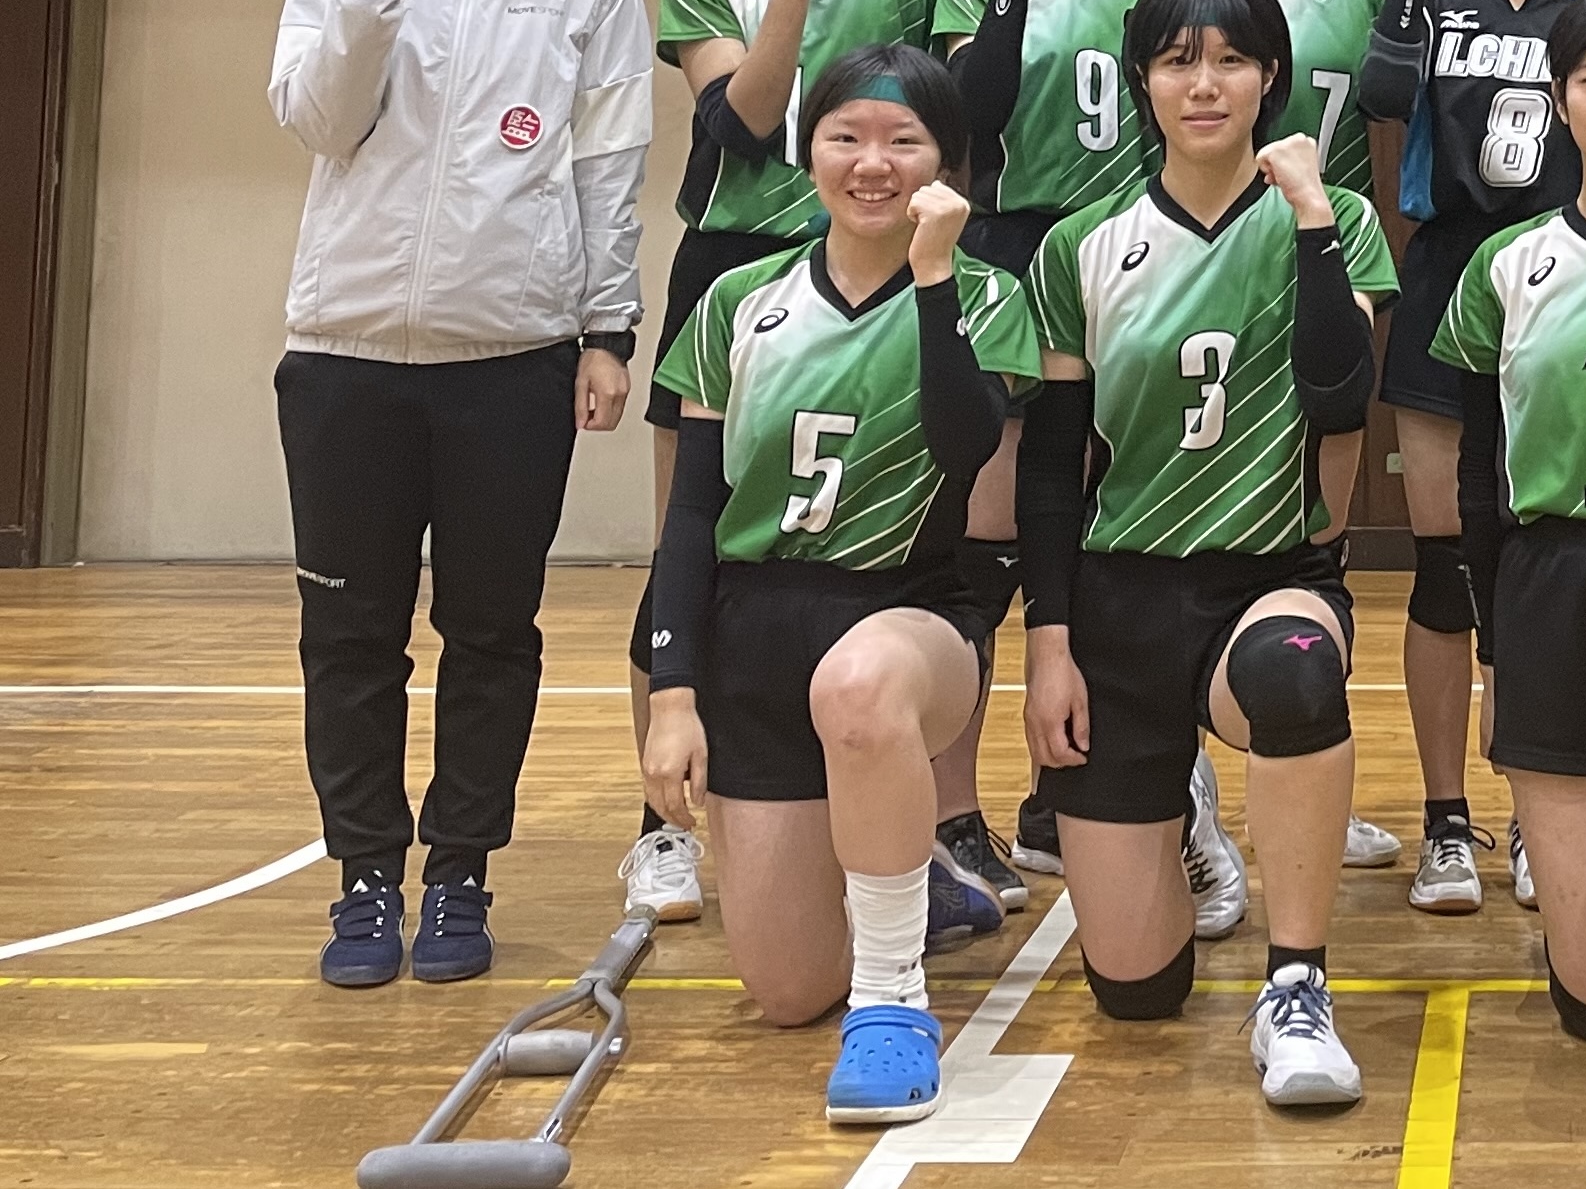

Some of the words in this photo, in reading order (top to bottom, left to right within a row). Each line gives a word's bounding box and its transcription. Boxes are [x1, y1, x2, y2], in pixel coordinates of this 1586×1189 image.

[1075, 49, 1120, 151] 9
[1435, 31, 1552, 82] I.CHI
[1311, 69, 1351, 174] 7
[1479, 88, 1553, 188] 8
[1178, 330, 1237, 451] 3
[780, 410, 857, 535] 5
